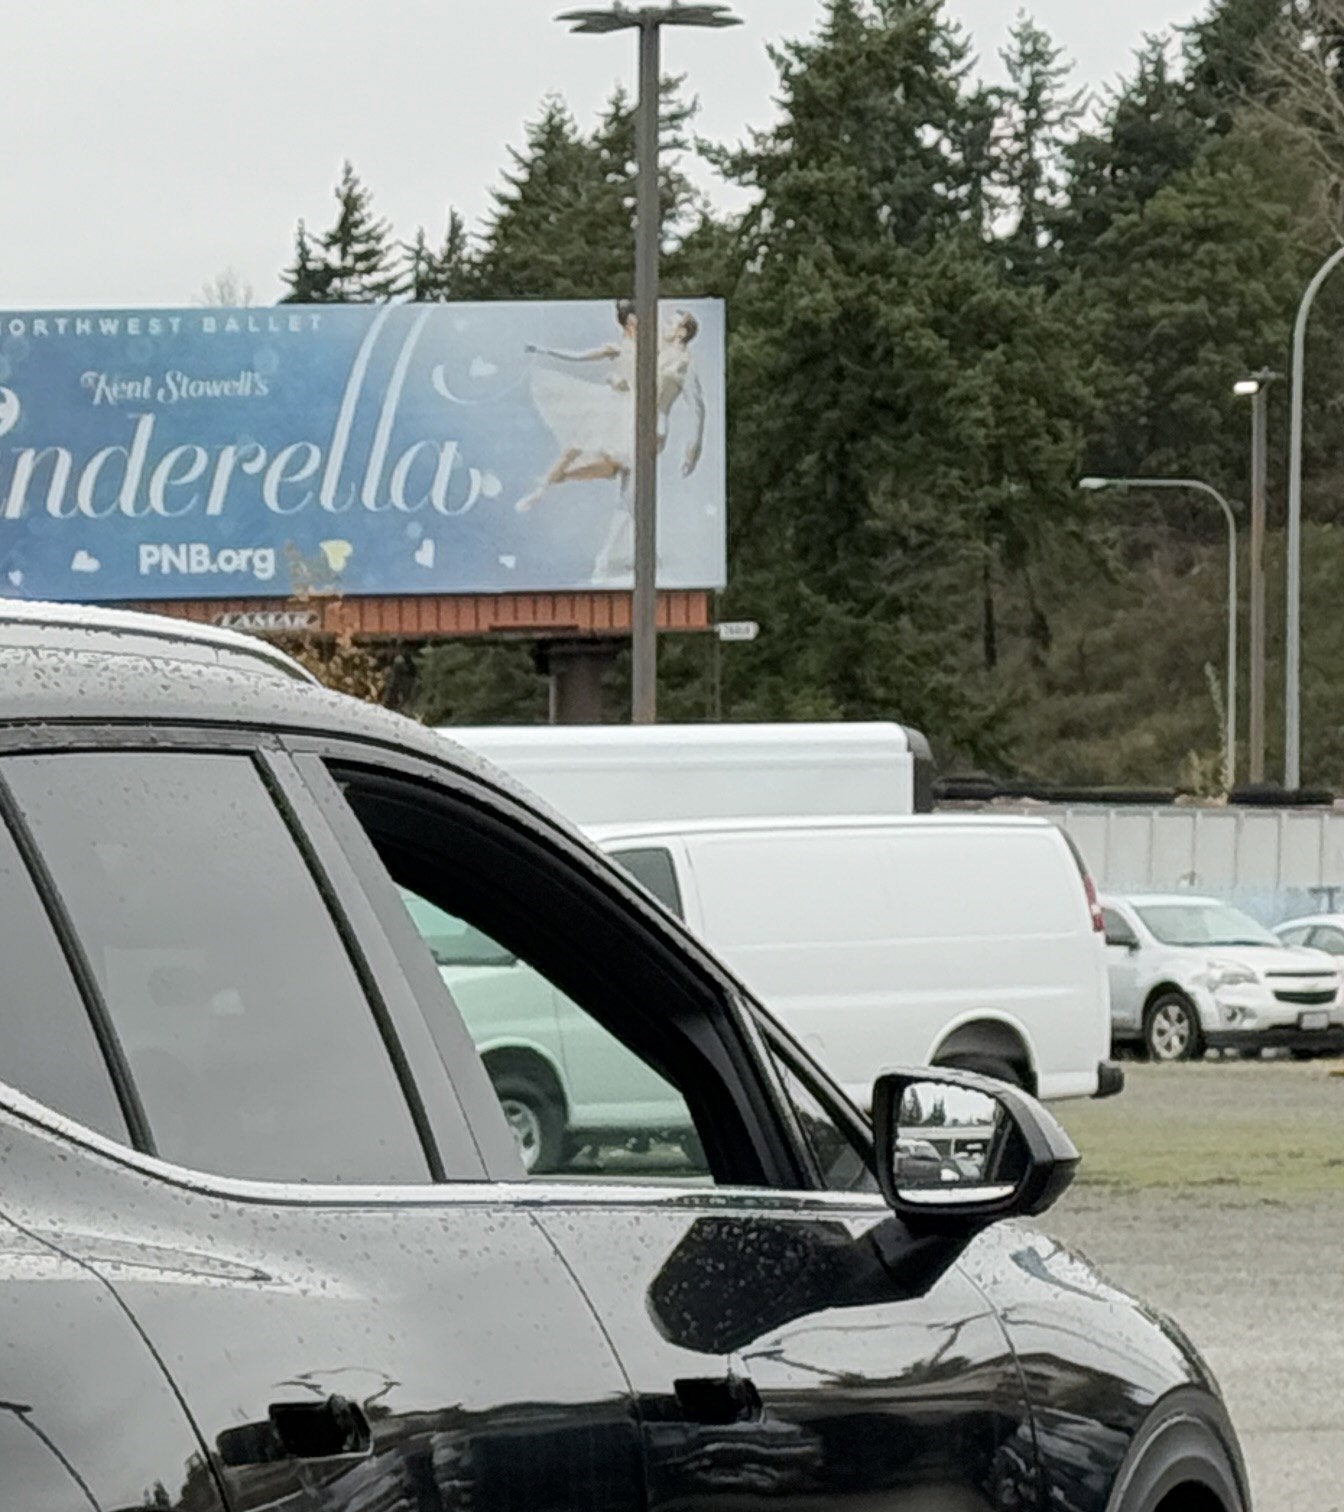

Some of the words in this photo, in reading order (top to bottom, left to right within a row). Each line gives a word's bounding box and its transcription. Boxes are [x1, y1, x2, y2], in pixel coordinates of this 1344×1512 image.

[202, 314, 322, 334] BALLET
[80, 370, 154, 406] Kent
[156, 369, 270, 404] Stowell's
[139, 543, 276, 580] PNB.org
